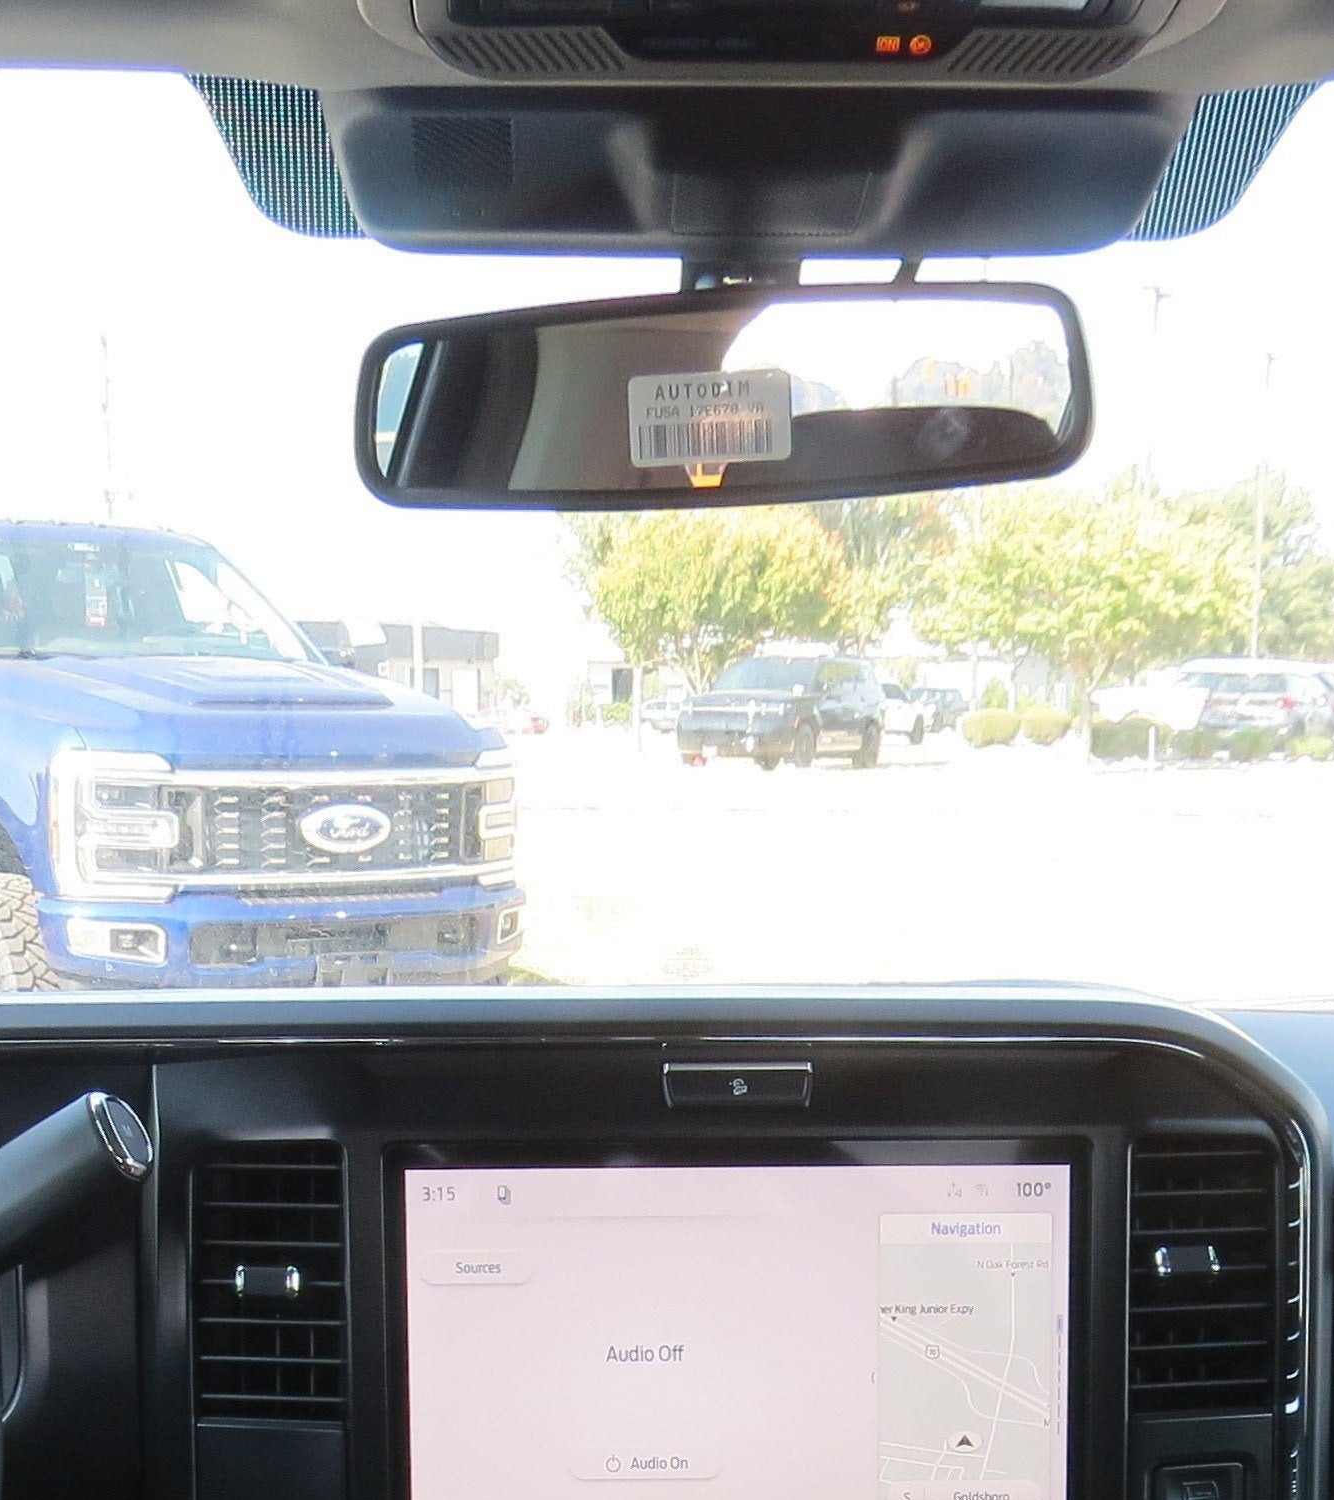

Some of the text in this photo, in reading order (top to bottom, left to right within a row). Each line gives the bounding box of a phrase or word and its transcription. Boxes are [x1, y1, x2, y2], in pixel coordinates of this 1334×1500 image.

[422, 1186, 456, 1202] 3:15
[1016, 1181, 1052, 1198] 100°
[930, 1221, 1002, 1237] Navigation
[455, 1262, 502, 1274] Sources
[977, 1259, 1049, 1269] N Oak Forest Rd
[894, 1304, 917, 1316] King
[919, 1304, 948, 1314] Junior
[950, 1303, 974, 1316] Expy
[606, 1345, 684, 1362] Audio Off
[630, 1456, 689, 1470] Audio On
